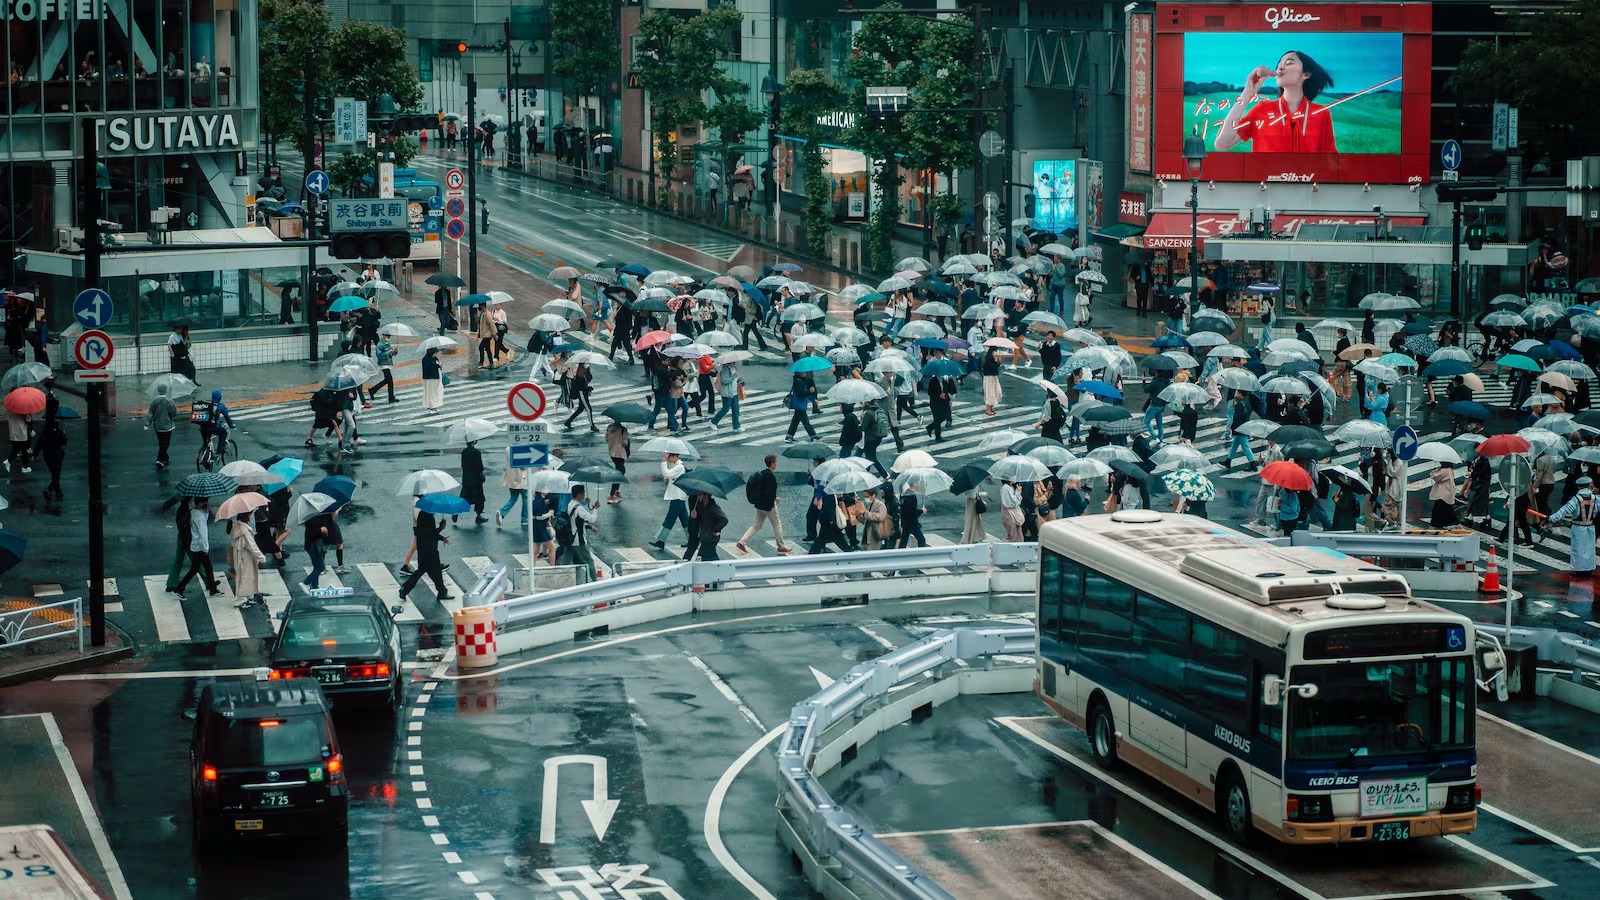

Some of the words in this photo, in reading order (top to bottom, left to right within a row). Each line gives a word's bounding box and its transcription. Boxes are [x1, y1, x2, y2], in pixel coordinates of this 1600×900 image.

[0, 0, 107, 21] COFFEE
[1265, 7, 1320, 29] Glico
[1135, 38, 1146, 165] 天津甘栗
[817, 111, 855, 128] AMERICAN
[336, 202, 402, 218] 渋谷駅前
[1120, 199, 1146, 217] 天津甘栗
[346, 219, 376, 228] Shibuya
[379, 219, 395, 227] Sta.
[1214, 724, 1233, 746] KEIO
[1233, 734, 1251, 754] BUS
[1309, 776, 1334, 786] KEIO
[1335, 775, 1359, 785] BUS
